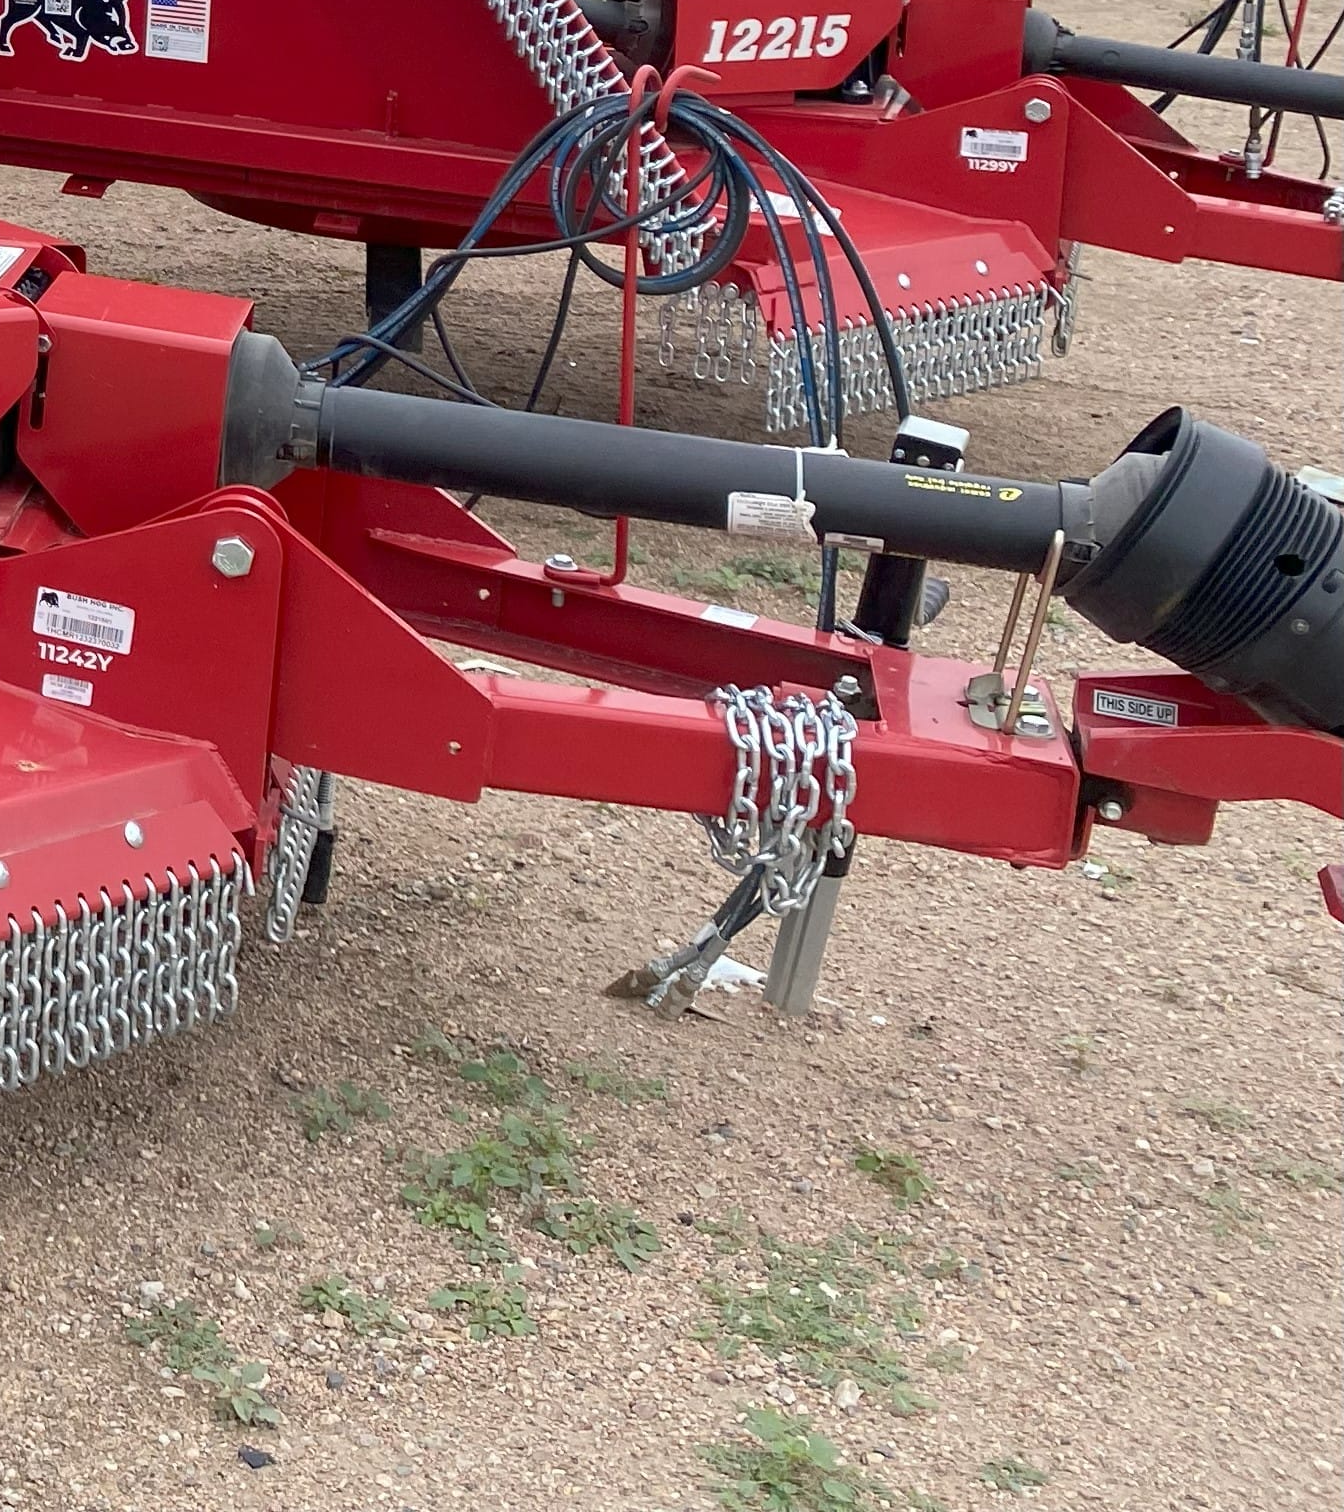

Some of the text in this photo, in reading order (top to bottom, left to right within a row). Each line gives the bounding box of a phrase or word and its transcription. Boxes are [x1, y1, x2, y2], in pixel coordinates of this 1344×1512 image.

[702, 14, 852, 63] 12215
[968, 158, 1019, 173] 11299Y
[38, 641, 113, 672] 11242Y
[1100, 695, 1172, 720] THIS SIDE UP
